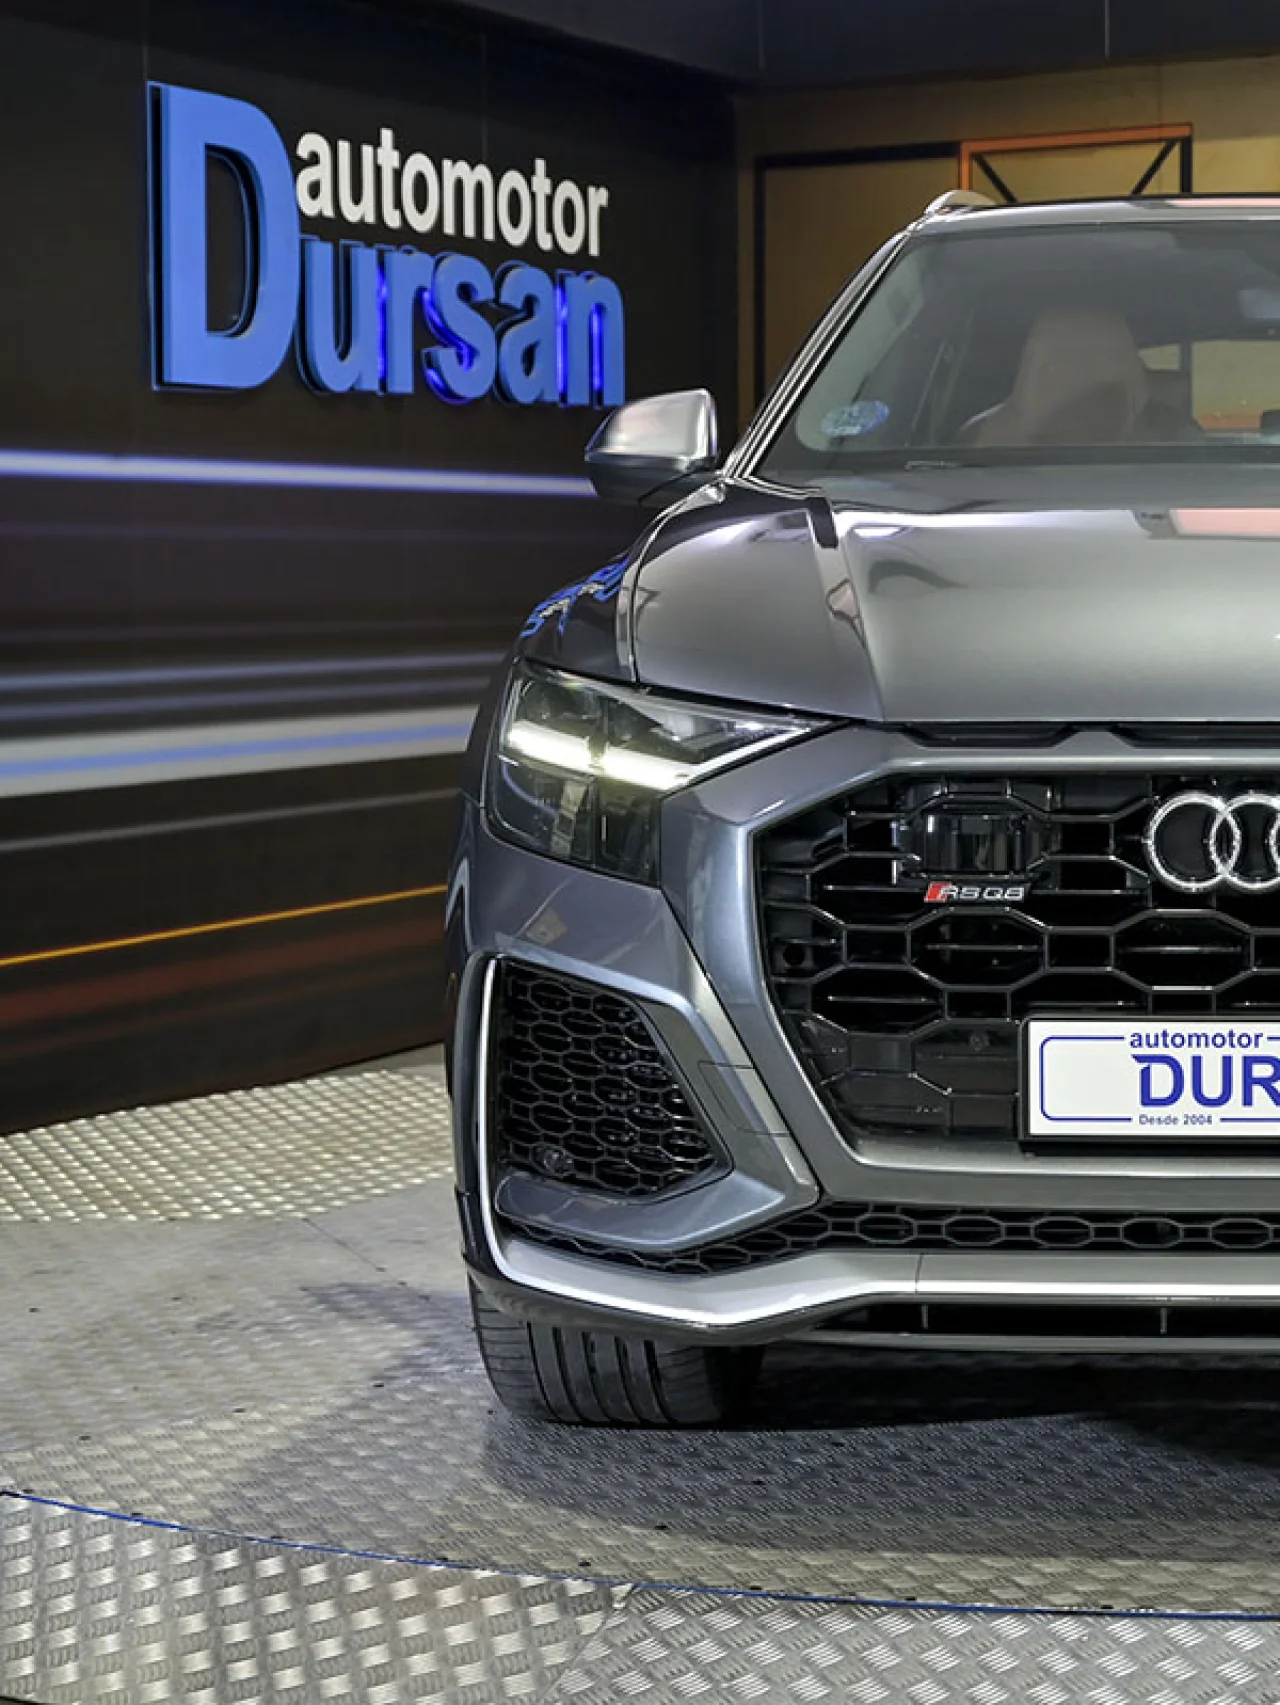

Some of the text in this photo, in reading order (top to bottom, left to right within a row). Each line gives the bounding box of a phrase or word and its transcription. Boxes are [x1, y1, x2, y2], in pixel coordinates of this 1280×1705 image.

[296, 127, 608, 256] automotor
[147, 80, 625, 407] Dursan
[1129, 1029, 1264, 1049] automotor
[1138, 1114, 1213, 1126] Desde 2004
